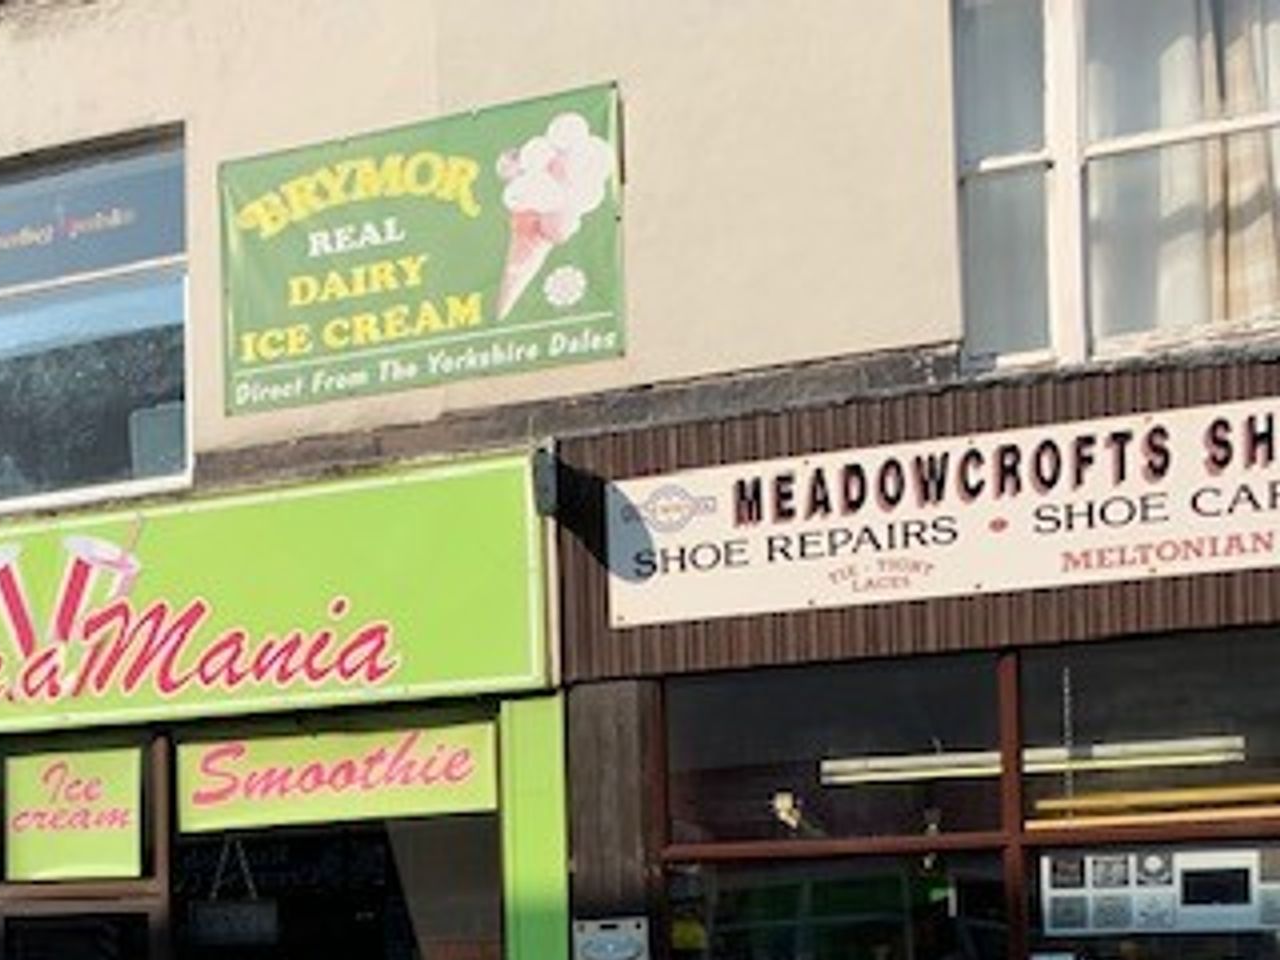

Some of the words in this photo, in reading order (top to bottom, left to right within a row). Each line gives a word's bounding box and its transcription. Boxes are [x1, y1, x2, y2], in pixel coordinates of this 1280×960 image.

[236, 150, 482, 240] BRYMOR
[306, 216, 406, 259] REAL
[287, 253, 428, 307] DAIRY
[239, 323, 313, 364] ICE
[322, 291, 483, 349] CREAM
[235, 373, 305, 406] Direct
[311, 366, 369, 394] From
[379, 357, 419, 383] The
[426, 339, 540, 376] Yorkshire
[547, 327, 617, 357] Dales
[731, 424, 1172, 531] MEADOWCROFTS
[632, 543, 750, 579] SHOE
[765, 515, 960, 564] REPAIRS
[1032, 491, 1170, 534] SHOE
[1060, 530, 1275, 573] MELTONIAN
[72, 597, 398, 699] Mania
[39, 757, 105, 805] Ice
[191, 729, 475, 807] Smoothie
[9, 806, 131, 833] cream
